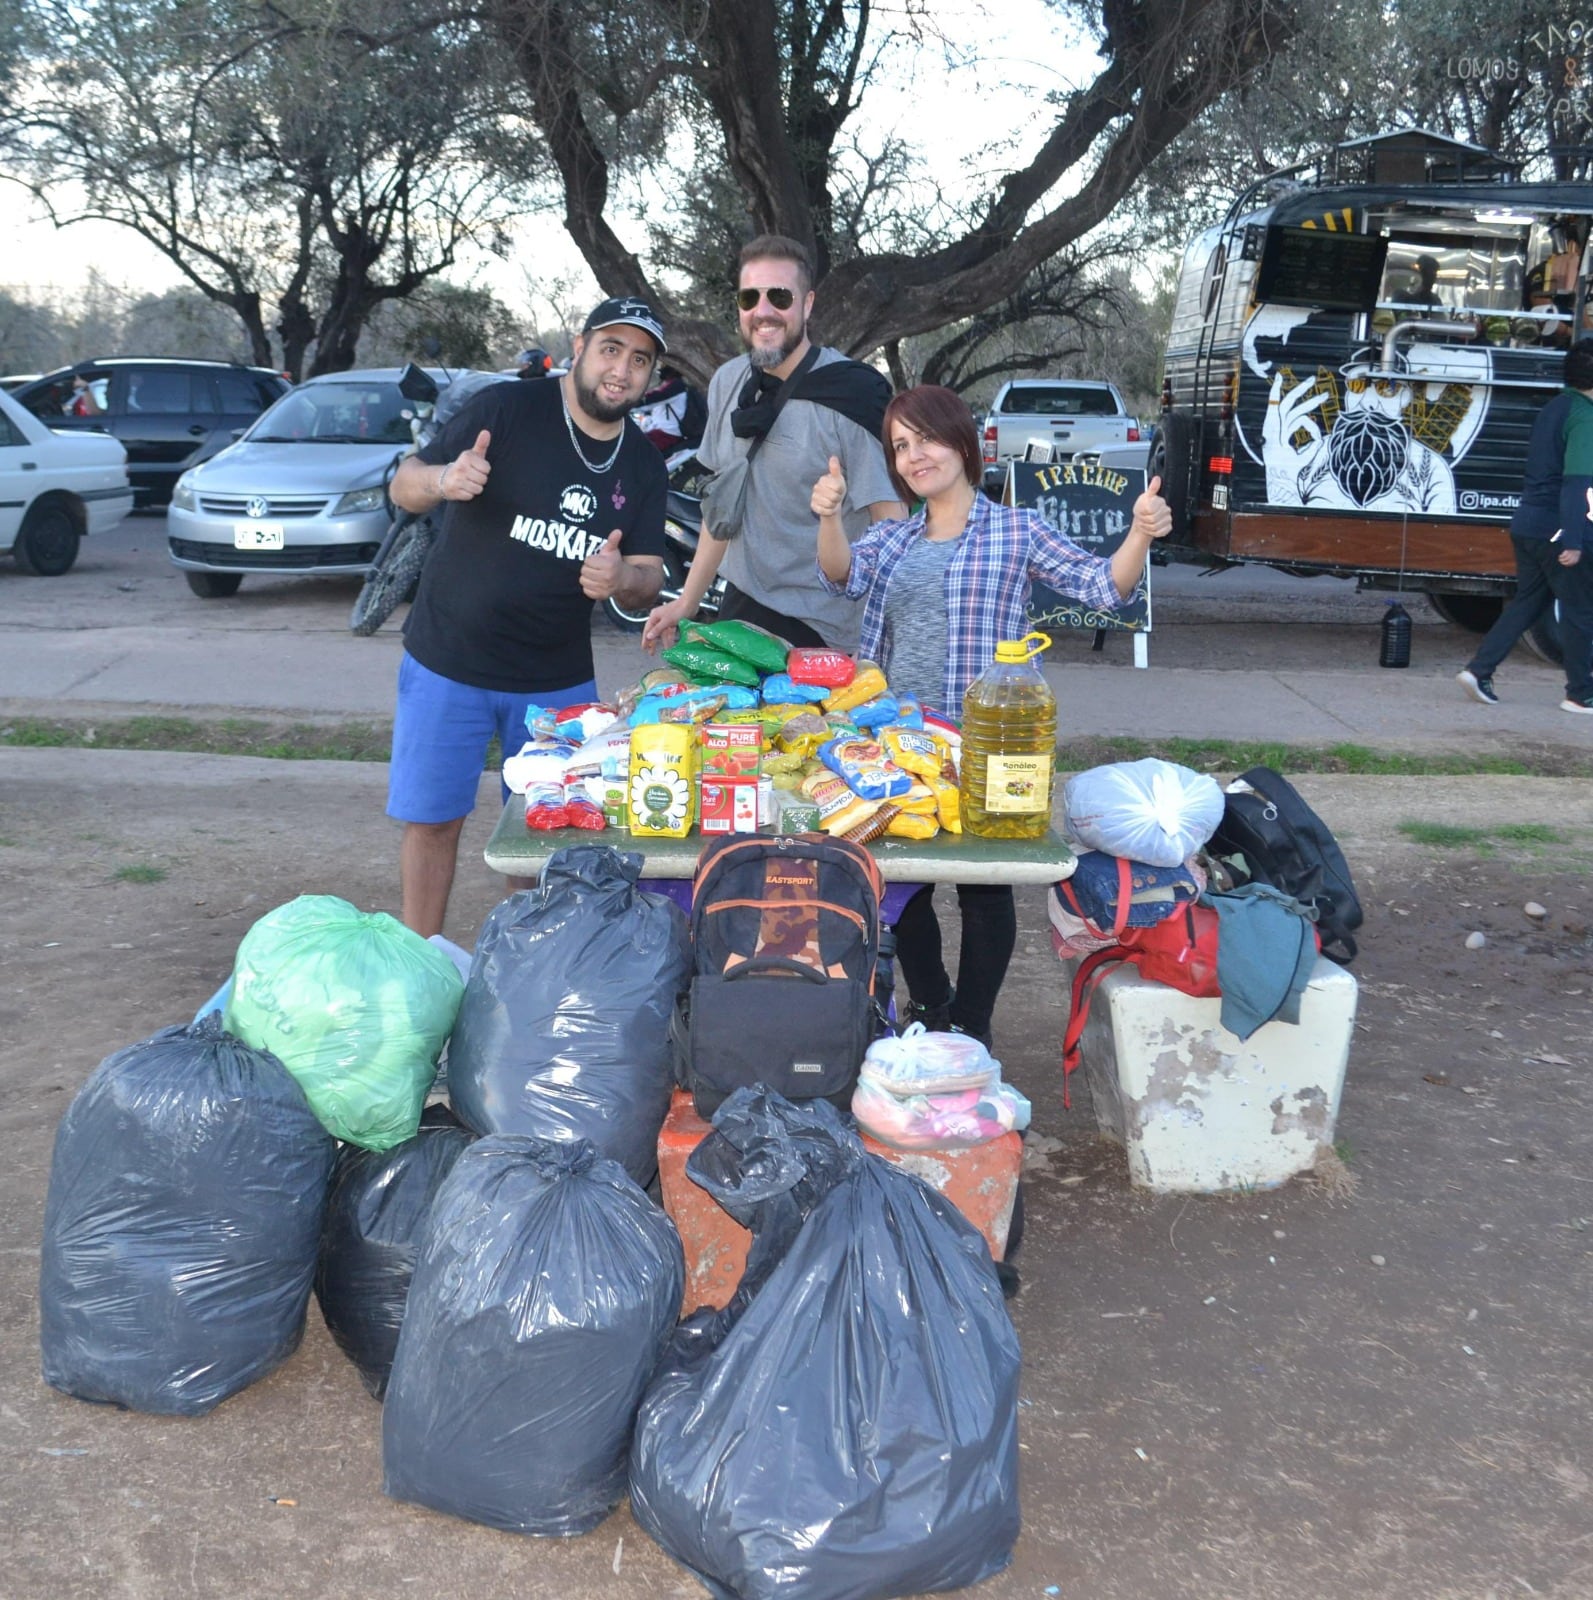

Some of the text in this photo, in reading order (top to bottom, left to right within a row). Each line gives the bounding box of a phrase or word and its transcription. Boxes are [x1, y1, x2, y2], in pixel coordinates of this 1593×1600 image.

[1447, 57, 1519, 81] LOMOS
[1035, 465, 1079, 491] IPA
[1036, 496, 1129, 536] Birra
[708, 740, 727, 748] ALCO
[766, 876, 815, 885] EASTSPORT
